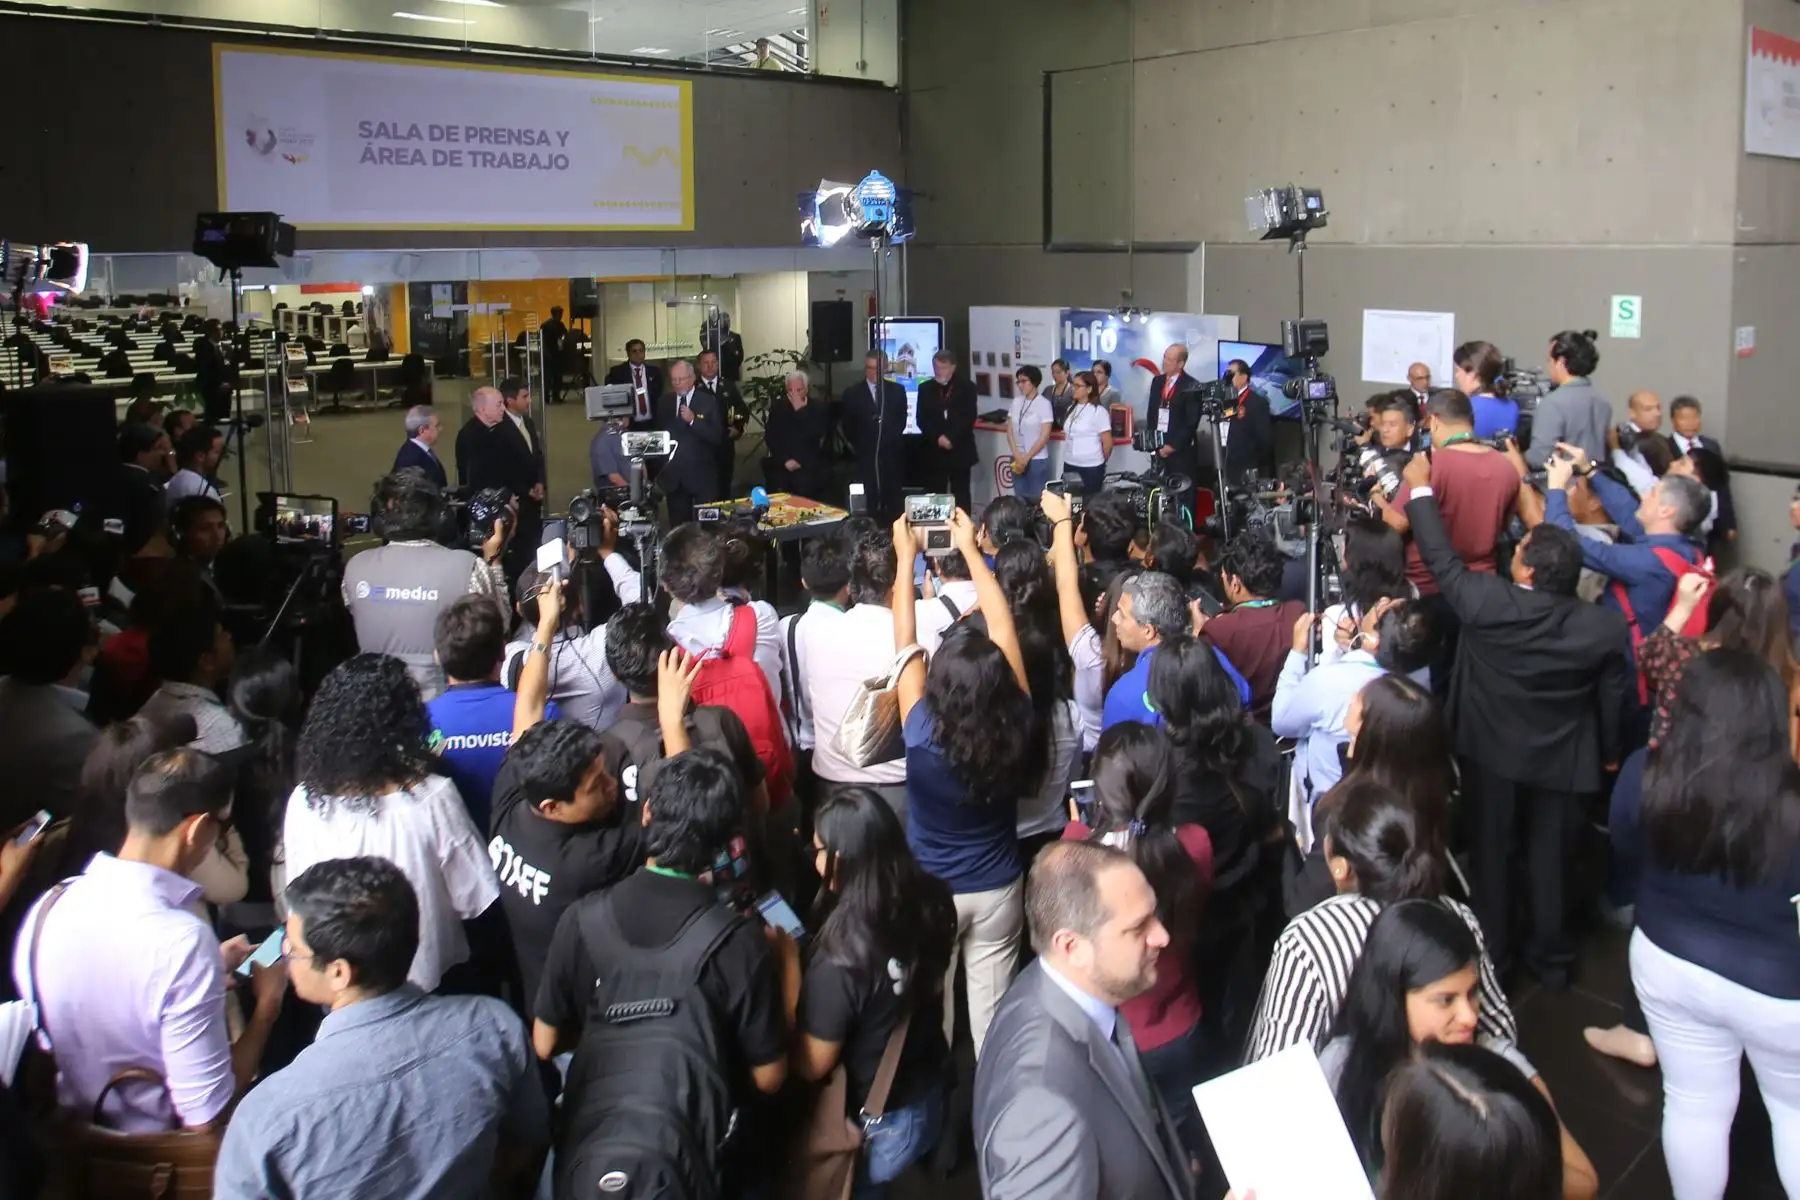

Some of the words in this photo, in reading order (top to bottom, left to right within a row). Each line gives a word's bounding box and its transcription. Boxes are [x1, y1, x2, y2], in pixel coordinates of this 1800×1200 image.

[358, 120, 424, 141] SALA
[428, 124, 460, 143] DE
[464, 125, 551, 147] PRENSA
[555, 130, 570, 147] Y
[359, 142, 427, 166] ÁREA
[432, 149, 463, 167] DE
[467, 151, 570, 171] TRABAJO
[1618, 299, 1634, 320] S
[1064, 319, 1117, 361] Info
[487, 834, 552, 906] STAFF
